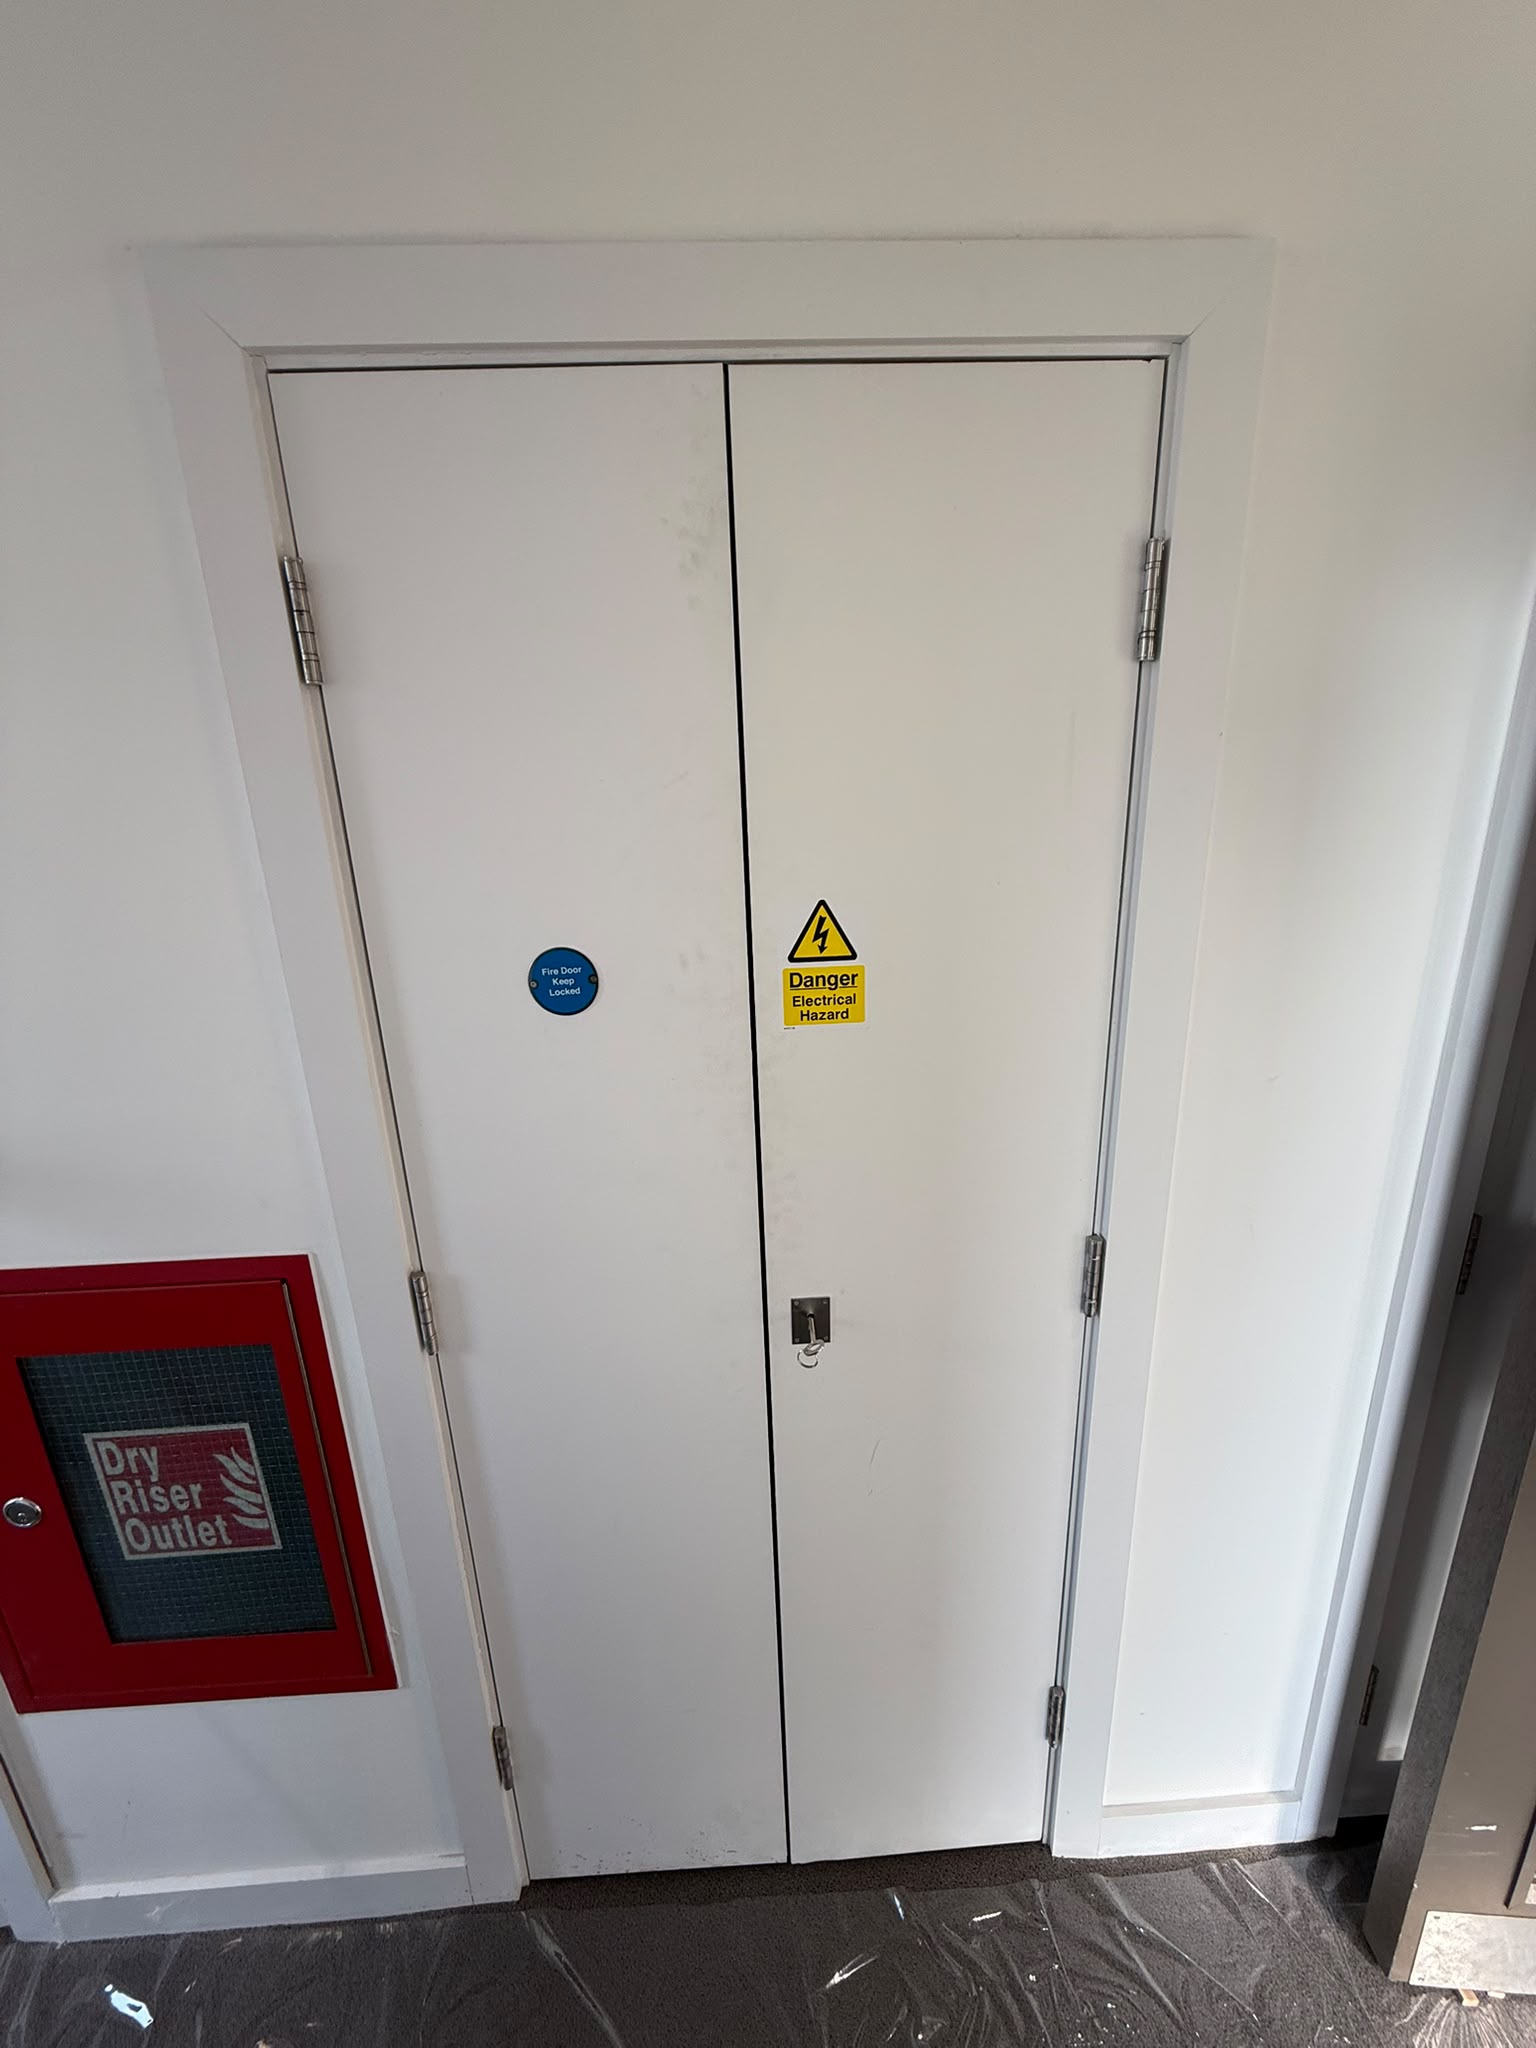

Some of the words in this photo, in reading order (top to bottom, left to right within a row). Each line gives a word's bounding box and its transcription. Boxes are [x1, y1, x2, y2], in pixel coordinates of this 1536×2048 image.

[541, 968, 559, 976] Fire
[560, 966, 582, 975] Door
[552, 978, 575, 986] Keep
[789, 972, 859, 990] Danger
[549, 987, 581, 997] Locked
[792, 993, 857, 1008] Electrical
[800, 1008, 849, 1022] Hazard
[96, 1440, 159, 1482] Dry
[109, 1479, 202, 1515] Riser
[125, 1514, 233, 1552] Outlet
